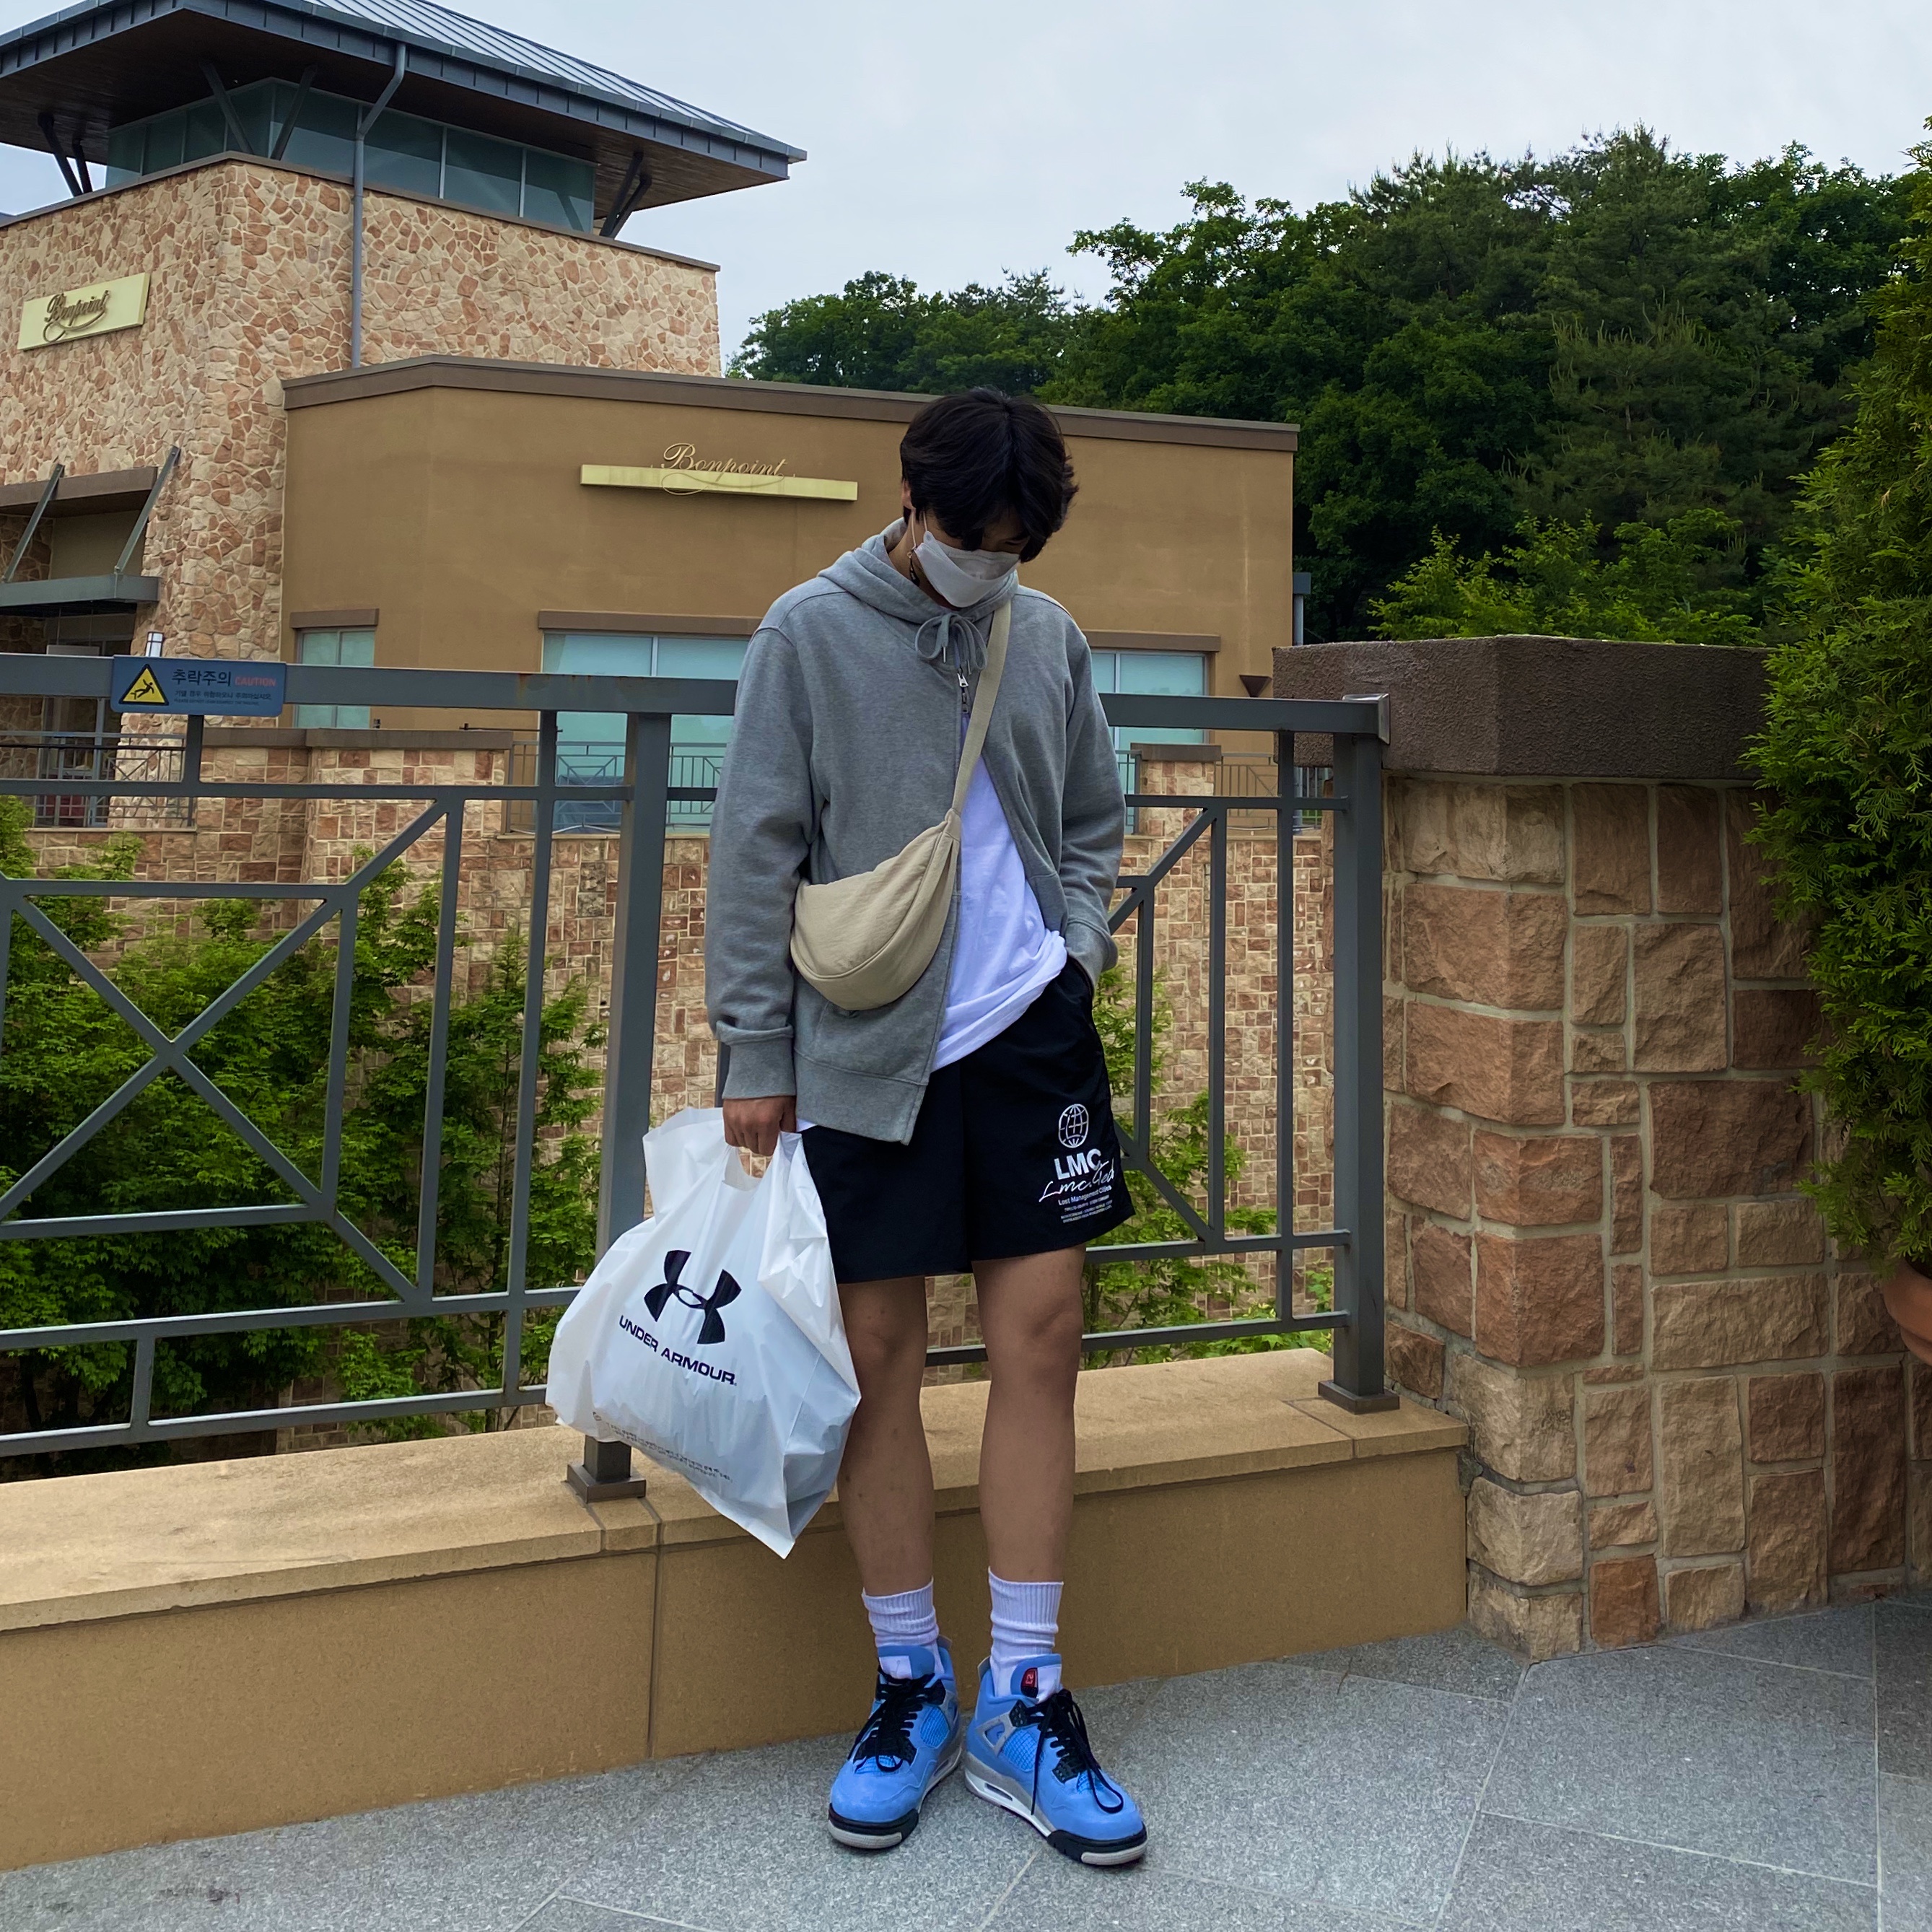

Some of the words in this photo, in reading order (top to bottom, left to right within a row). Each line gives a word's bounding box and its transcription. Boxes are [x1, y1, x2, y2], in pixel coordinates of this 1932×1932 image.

[660, 442, 787, 495] Bonpoint
[172, 668, 231, 686] 추락주의
[235, 676, 276, 687] CAUTION
[1054, 1148, 1101, 1180] LMC
[619, 1315, 658, 1352] UNDER
[661, 1347, 735, 1385] ARMOUR
